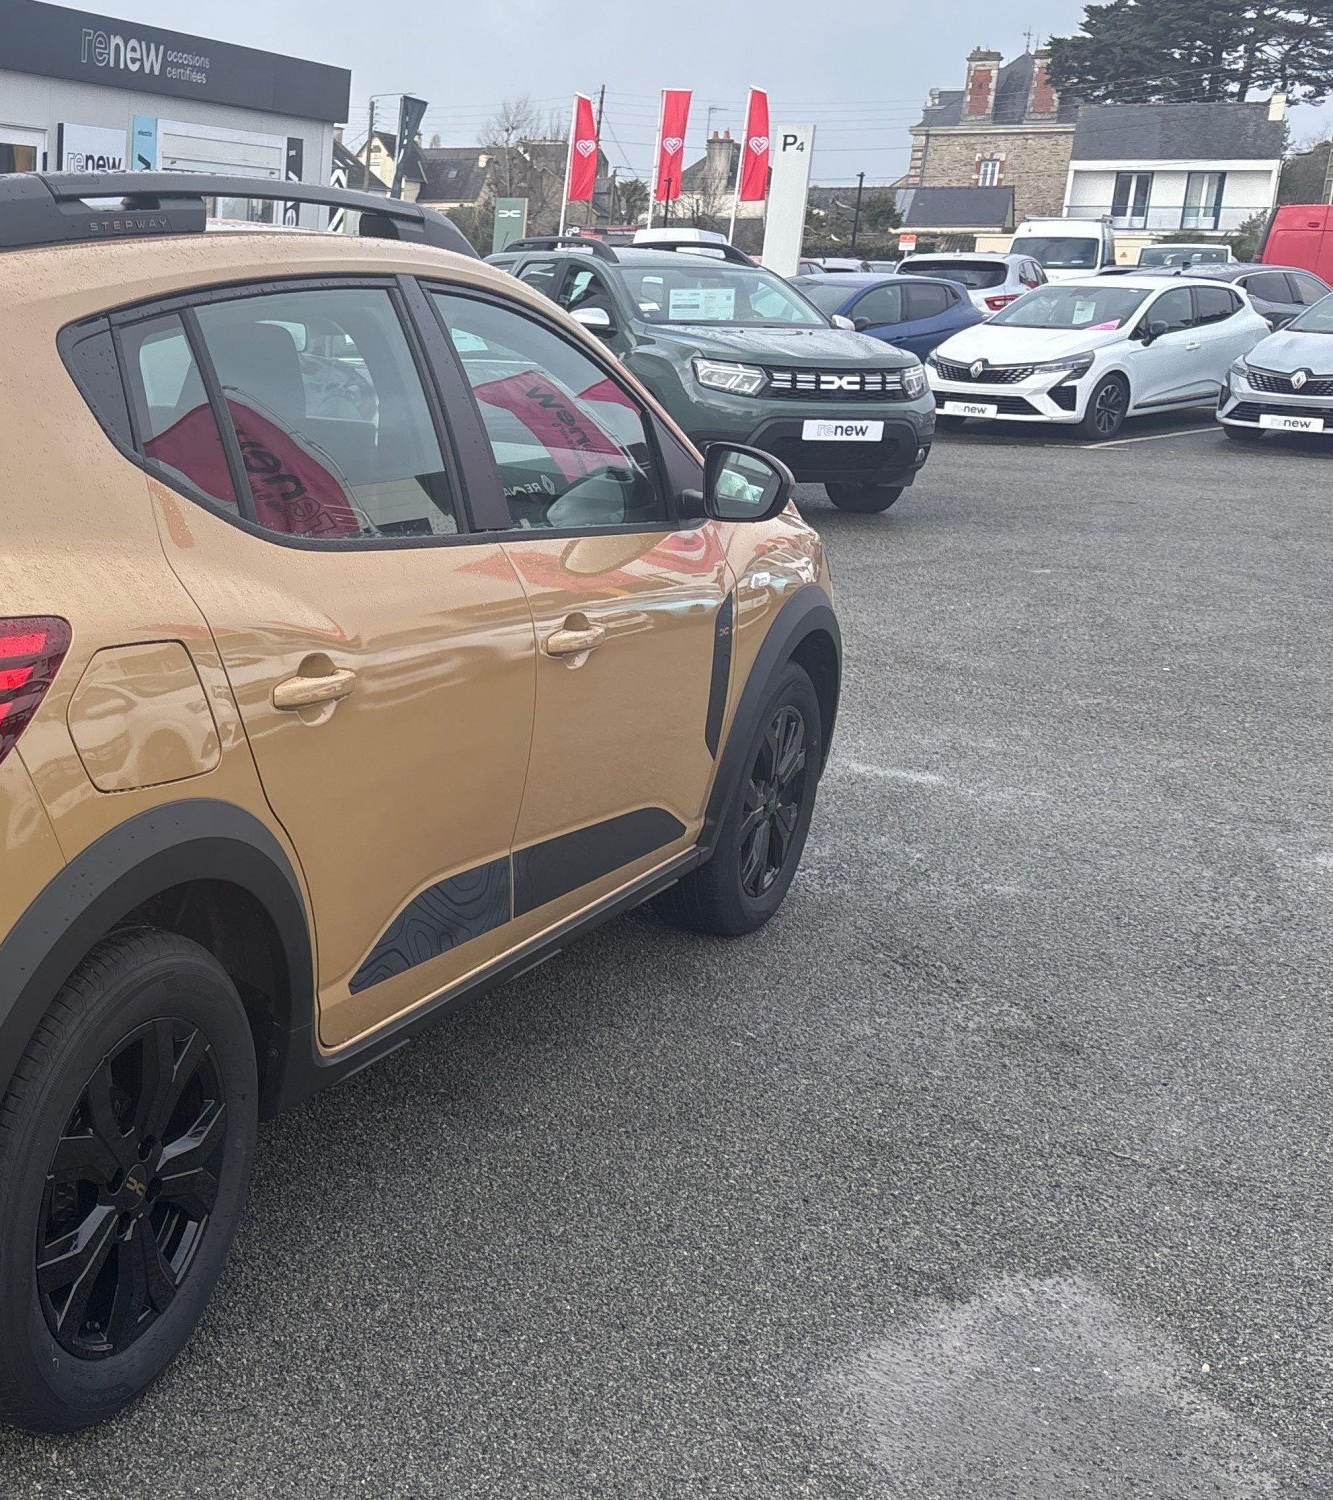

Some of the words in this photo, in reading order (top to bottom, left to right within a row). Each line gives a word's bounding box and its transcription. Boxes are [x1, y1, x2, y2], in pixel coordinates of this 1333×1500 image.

[81, 28, 164, 76] renew
[167, 50, 210, 69] occasions
[167, 66, 207, 84] certifiées
[67, 152, 122, 172] renew
[90, 218, 167, 231] STEPWAY
[816, 424, 869, 436] renew
